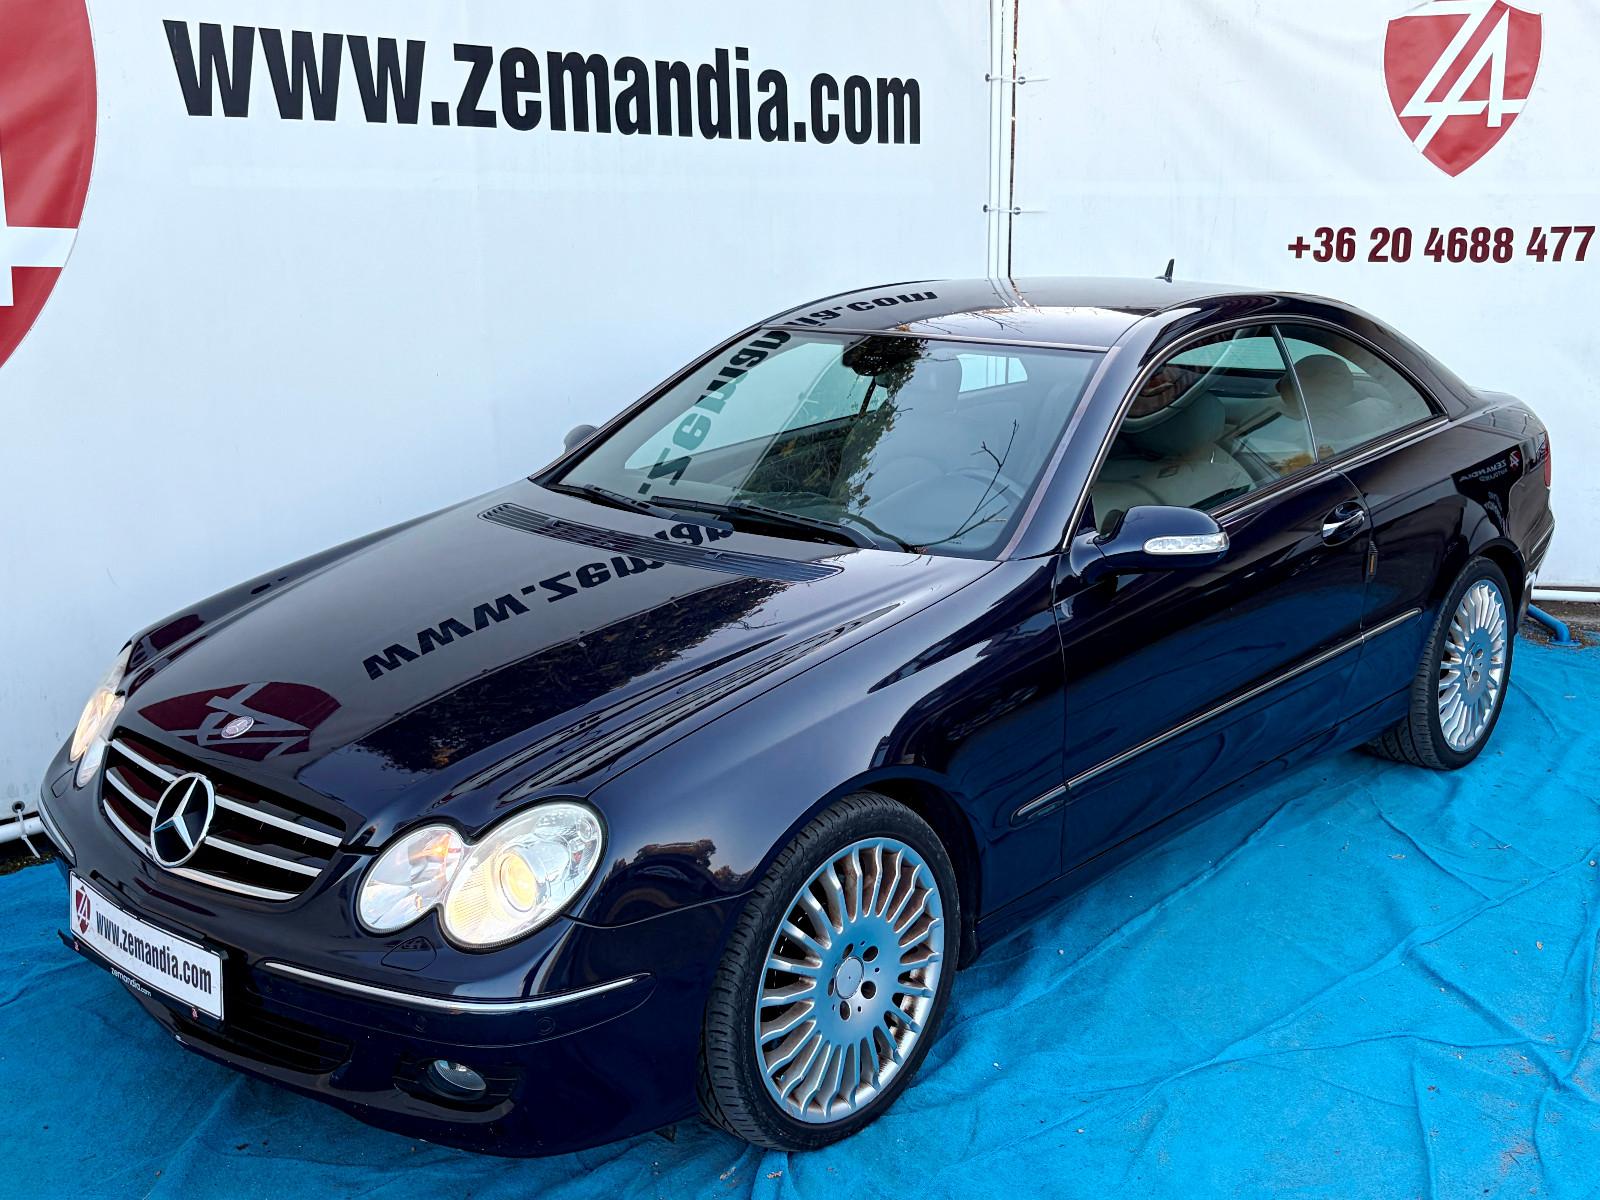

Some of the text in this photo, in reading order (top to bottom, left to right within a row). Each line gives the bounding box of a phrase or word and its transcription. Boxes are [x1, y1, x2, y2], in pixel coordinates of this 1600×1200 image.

[163, 20, 920, 144] www.zemandia.com
[1288, 226, 1596, 263] +36 20 4688 477
[96, 910, 212, 995] www.zemandia.com
[111, 967, 152, 998] zemandia.com
